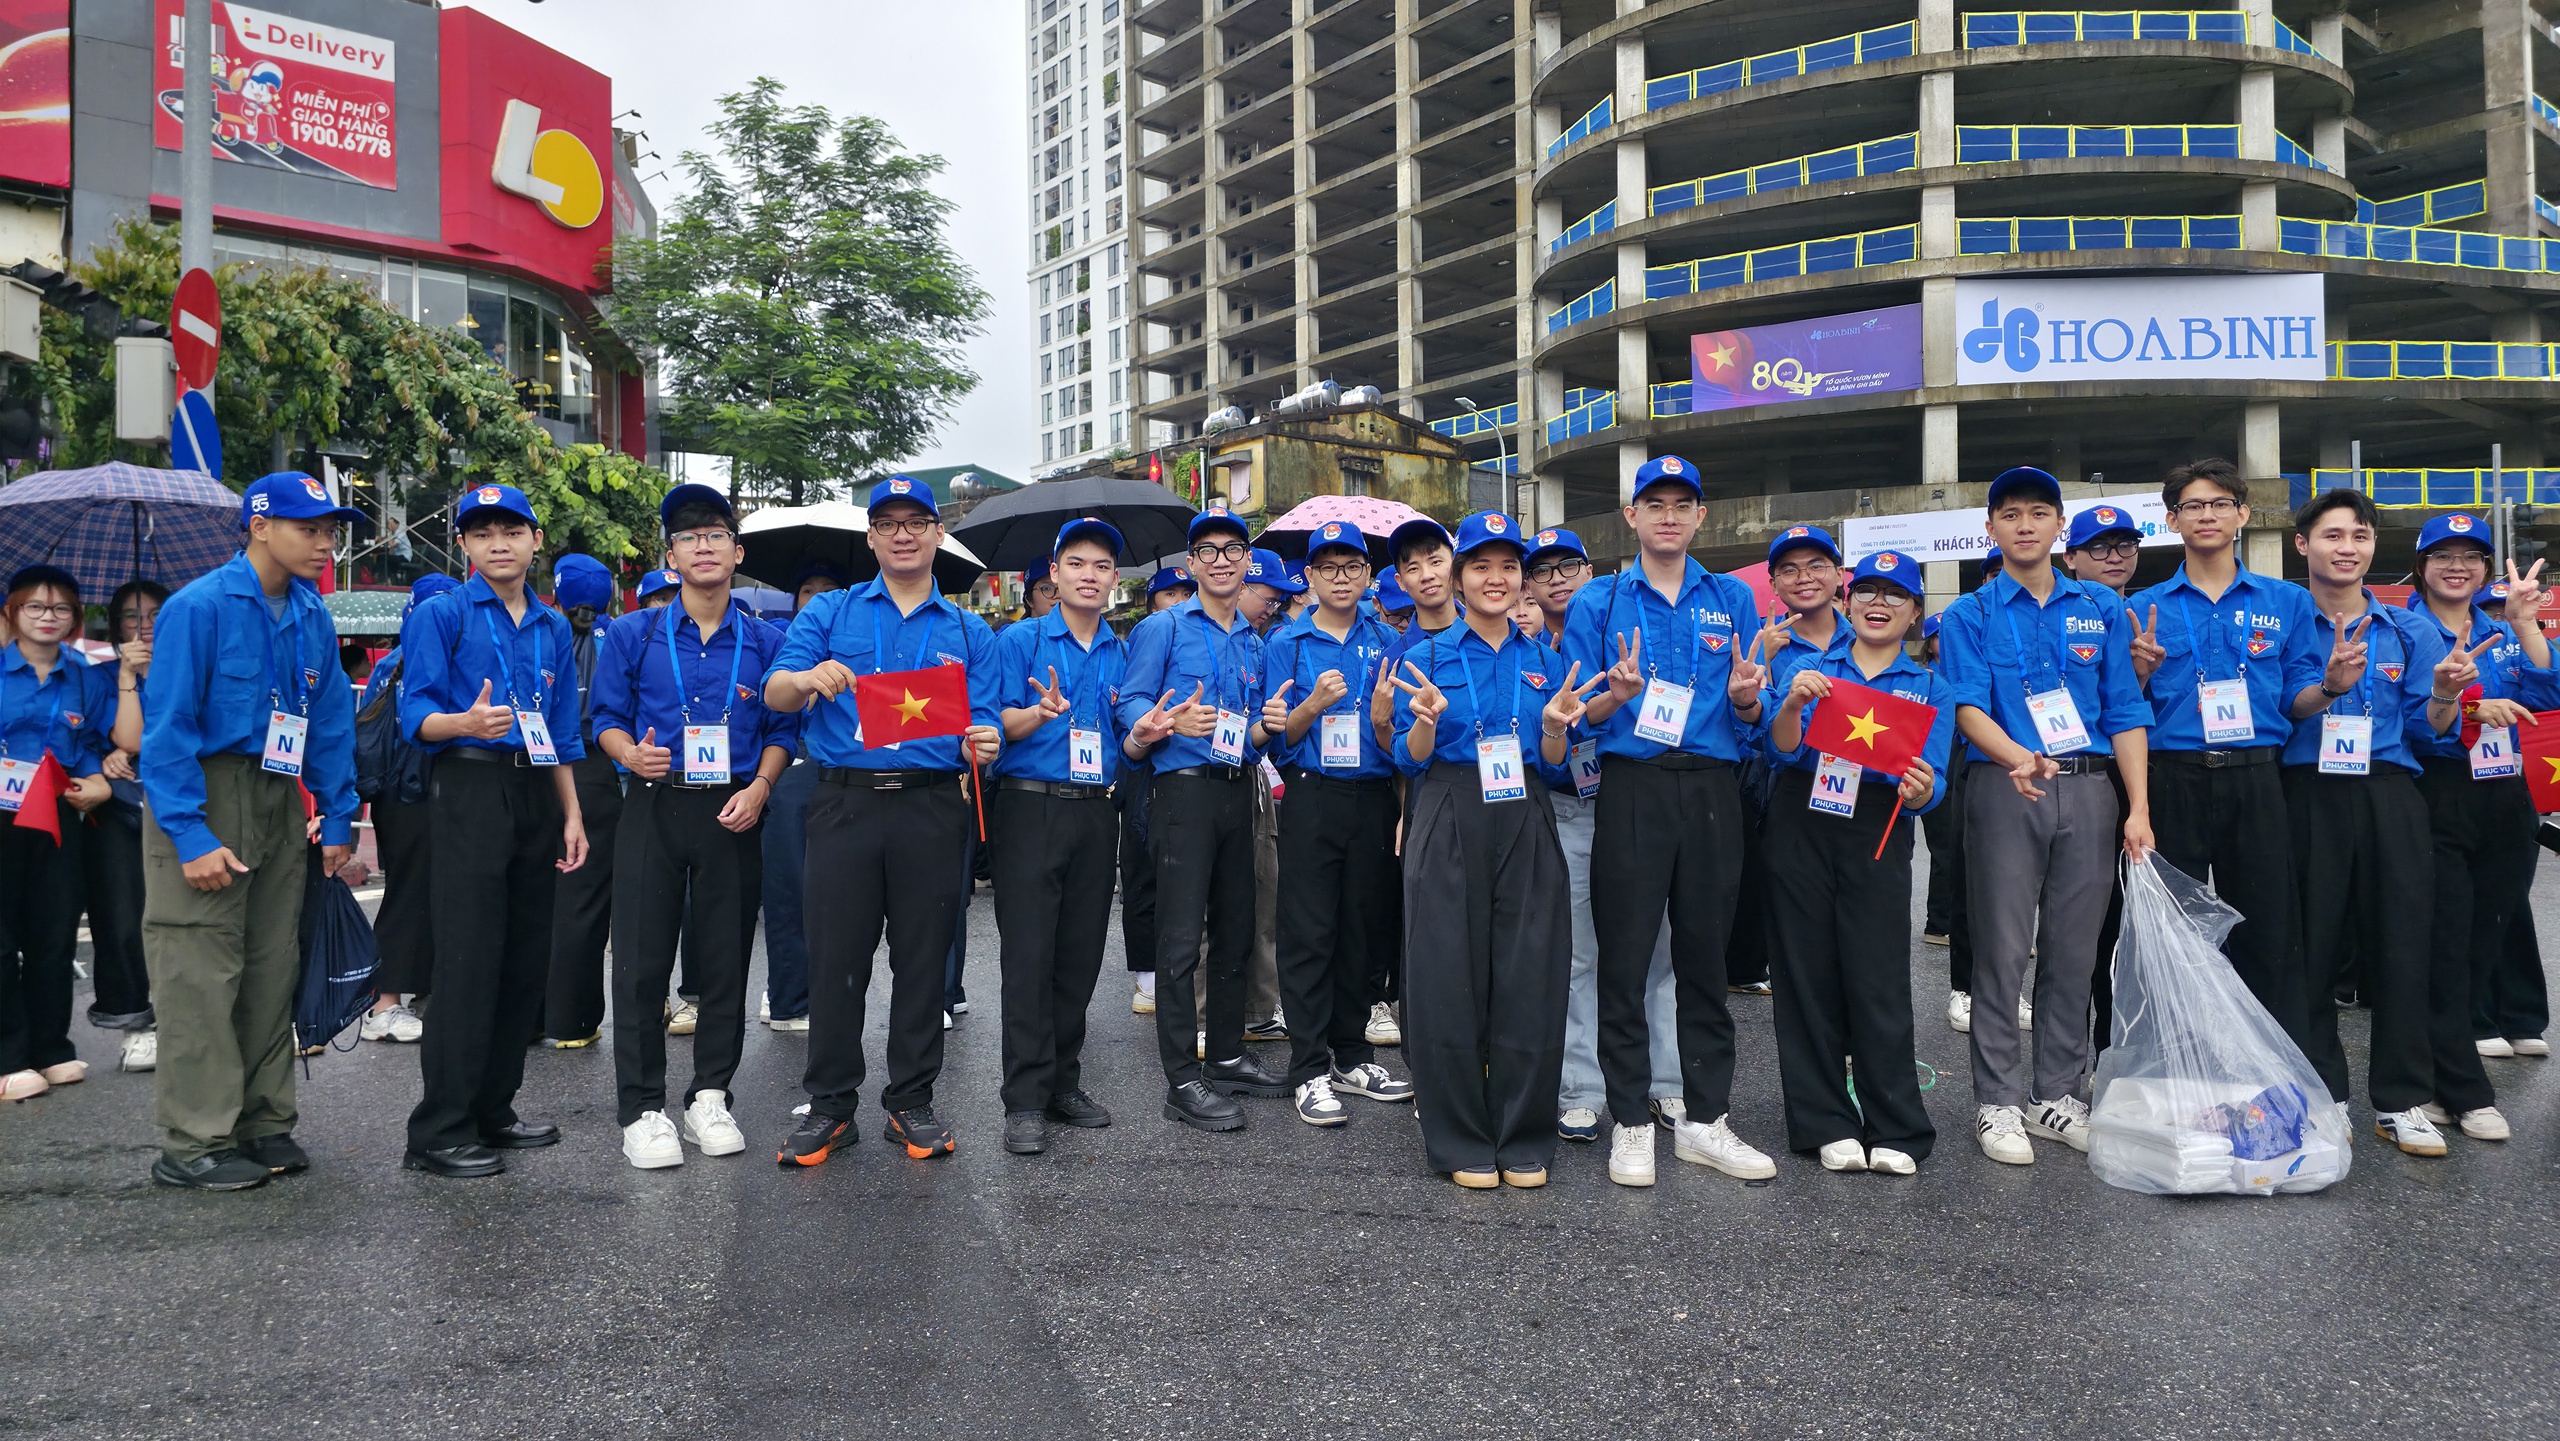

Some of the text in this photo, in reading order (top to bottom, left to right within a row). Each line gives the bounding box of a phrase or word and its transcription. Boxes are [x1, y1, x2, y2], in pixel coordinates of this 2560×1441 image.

[267, 23, 386, 70] Delivery
[293, 89, 372, 119] MIỄN PHÍ
[291, 107, 388, 138] GIAO HÀNG
[290, 121, 392, 158] 1900.6778
[1823, 327, 1860, 339] HOABINH
[2048, 316, 2318, 363] HOABINH
[1751, 358, 1803, 391] 80
[1834, 376, 1852, 385] QUỐC
[252, 497, 270, 512] 5G
[1933, 536, 1974, 551] KHÁCH
[1706, 611, 1732, 625] HUS
[2077, 619, 2105, 631] HUS
[2251, 613, 2281, 629] HUS
[1906, 691, 1929, 705] HU
[1654, 704, 1674, 724] N
[2216, 704, 2236, 721] N
[2048, 714, 2069, 733] N
[530, 730, 545, 746] N
[1222, 729, 1236, 747] N
[1333, 733, 1348, 748] N
[1641, 726, 1675, 742] PHỤC VỤ
[2212, 728, 2247, 738] PHỤC VỤ
[277, 734, 294, 753] N
[2050, 737, 2083, 750] PHỤC VỤ
[2335, 738, 2355, 754] N
[2481, 741, 2500, 759] N
[698, 746, 715, 763] N
[1079, 748, 1092, 765] N
[1214, 749, 1238, 764] PHỤC VỤ
[1326, 756, 1355, 764] PHỤC VỤ
[267, 759, 297, 773] PHỤC VỤ
[1492, 761, 1510, 780] N
[1581, 758, 1600, 777] N
[2325, 762, 2362, 771] PHỤC VỤ
[2477, 766, 2510, 776] PHỤC VỤ
[712, 772, 724, 780] VỤ
[1074, 771, 1090, 779] PHỤC
[6, 777, 25, 794] N
[1826, 774, 1846, 794] N
[1488, 788, 1520, 799] PHỤC VỤ
[1814, 799, 1848, 813] PHỤC VỤ
